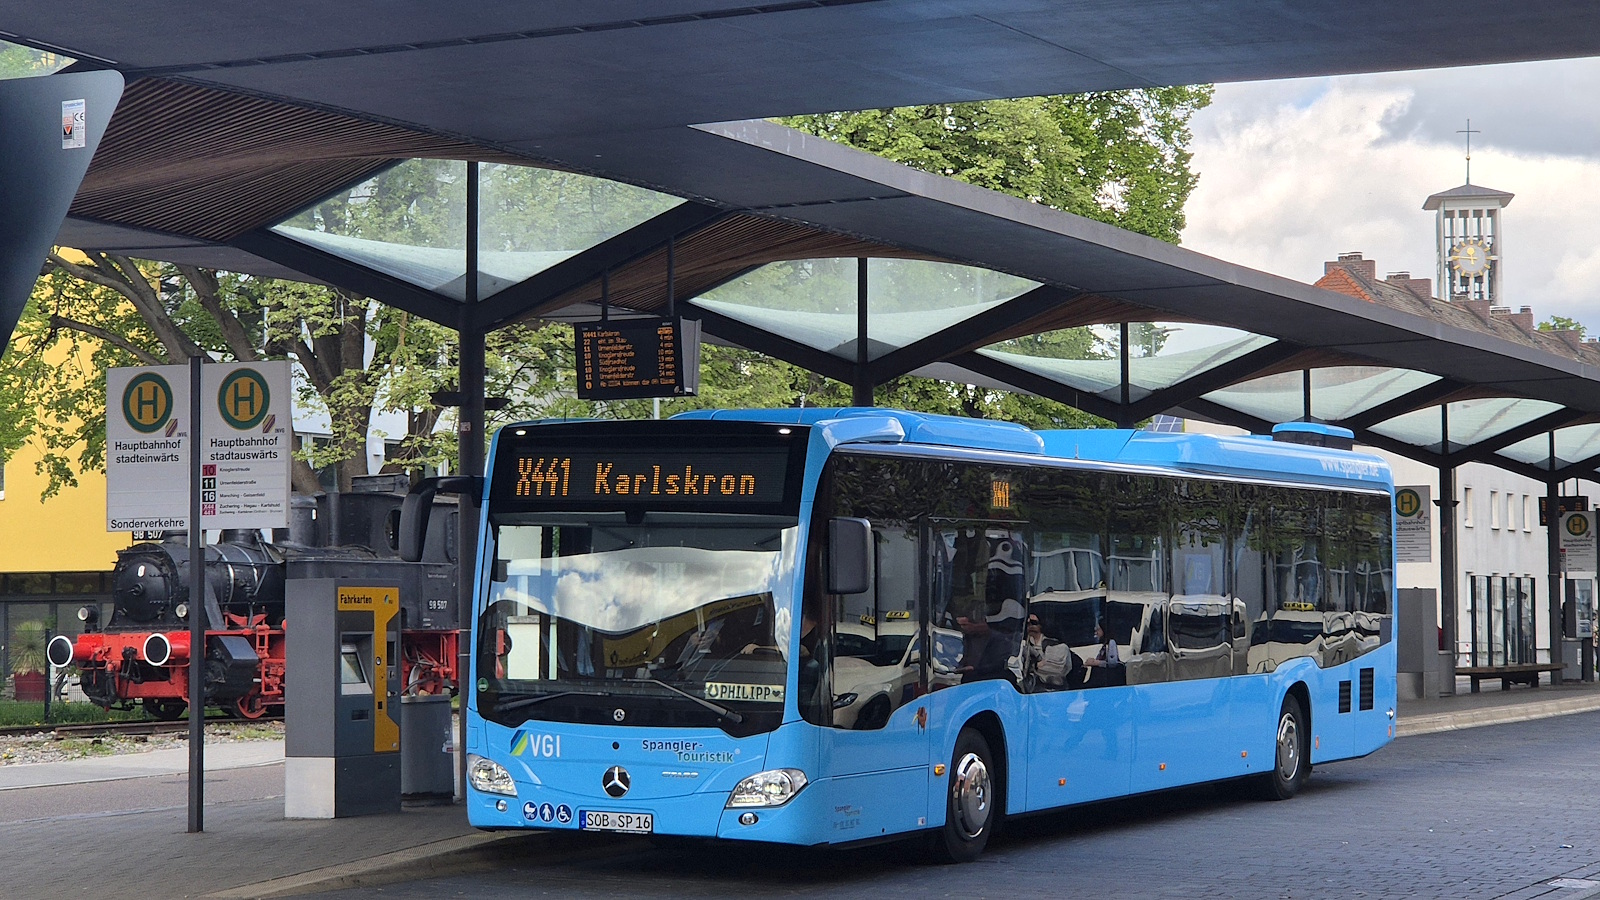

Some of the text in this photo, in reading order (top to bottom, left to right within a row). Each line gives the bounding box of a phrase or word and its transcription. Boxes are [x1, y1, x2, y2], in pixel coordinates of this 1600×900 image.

[138, 386, 158, 419] H
[234, 382, 254, 416] H
[115, 439, 181, 451] Hauptbahnhof
[210, 437, 278, 449] Hauptbahnhof
[116, 453, 179, 464] stadteinwärts
[210, 450, 278, 460] stadtauswärts
[203, 466, 216, 476] 10
[516, 458, 756, 496] X441 Karlskron
[204, 479, 214, 488] 11
[204, 492, 215, 501] 16
[1401, 495, 1412, 510] H
[111, 519, 184, 528] Sonderverkehre
[1573, 519, 1581, 530] H
[134, 531, 164, 539] 98 507
[340, 594, 372, 604] Fahrkarten
[429, 600, 447, 609] 98 507
[720, 685, 771, 699] PHILIPP
[529, 734, 561, 758] VGI
[642, 740, 703, 752] Spangler-
[677, 751, 733, 762] Touristik
[587, 813, 650, 829] SOB SP 16
